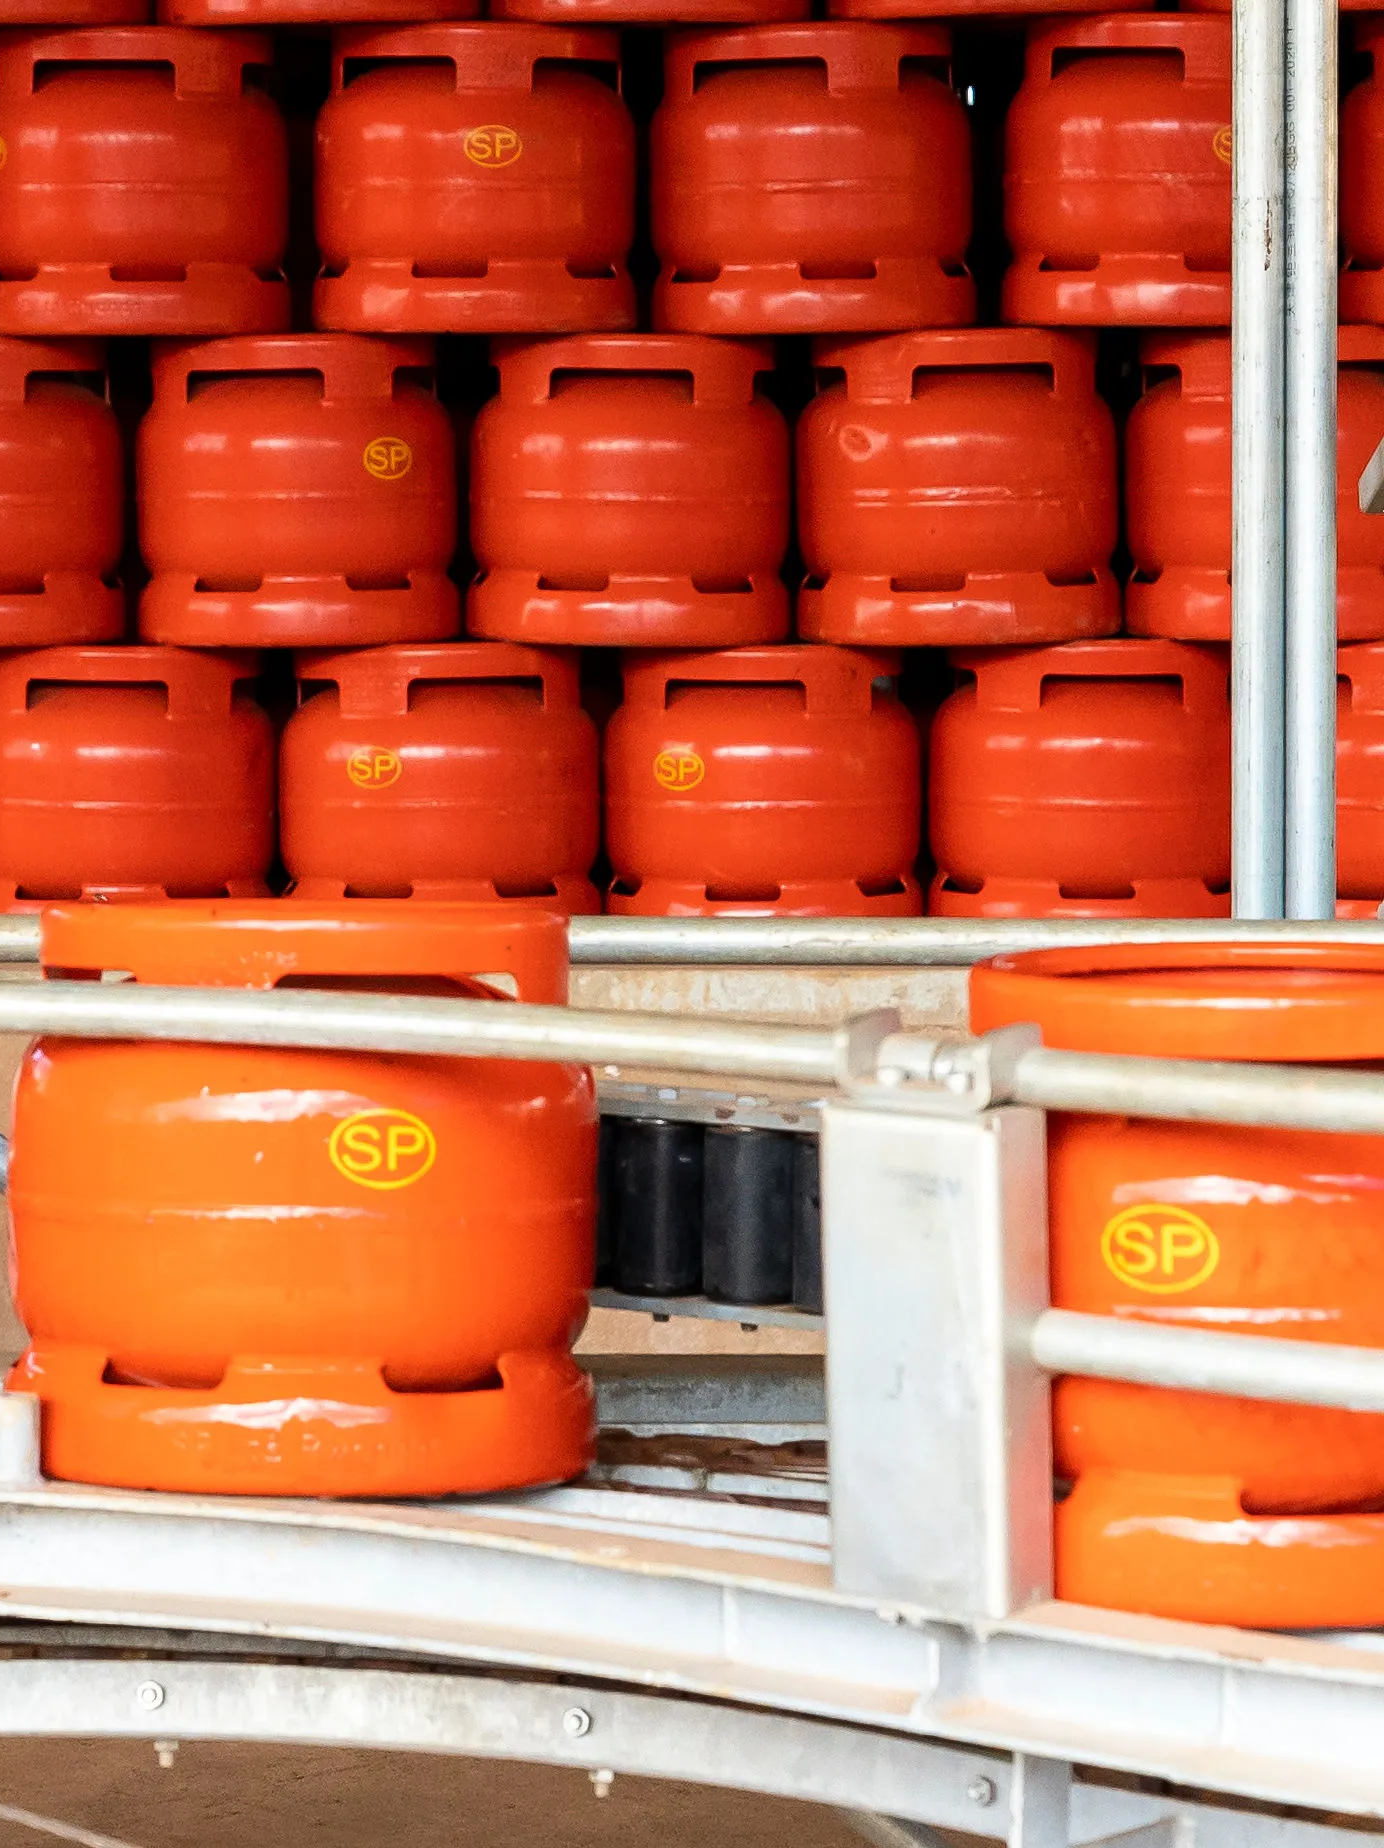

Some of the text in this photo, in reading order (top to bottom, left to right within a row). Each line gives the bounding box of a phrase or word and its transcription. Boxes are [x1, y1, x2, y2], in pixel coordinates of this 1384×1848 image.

[470, 132, 516, 159] SP
[369, 445, 407, 470] SP
[352, 755, 395, 781] SP
[658, 756, 698, 782] SP
[342, 1125, 425, 1172] SP
[1115, 1222, 1204, 1274] SP
